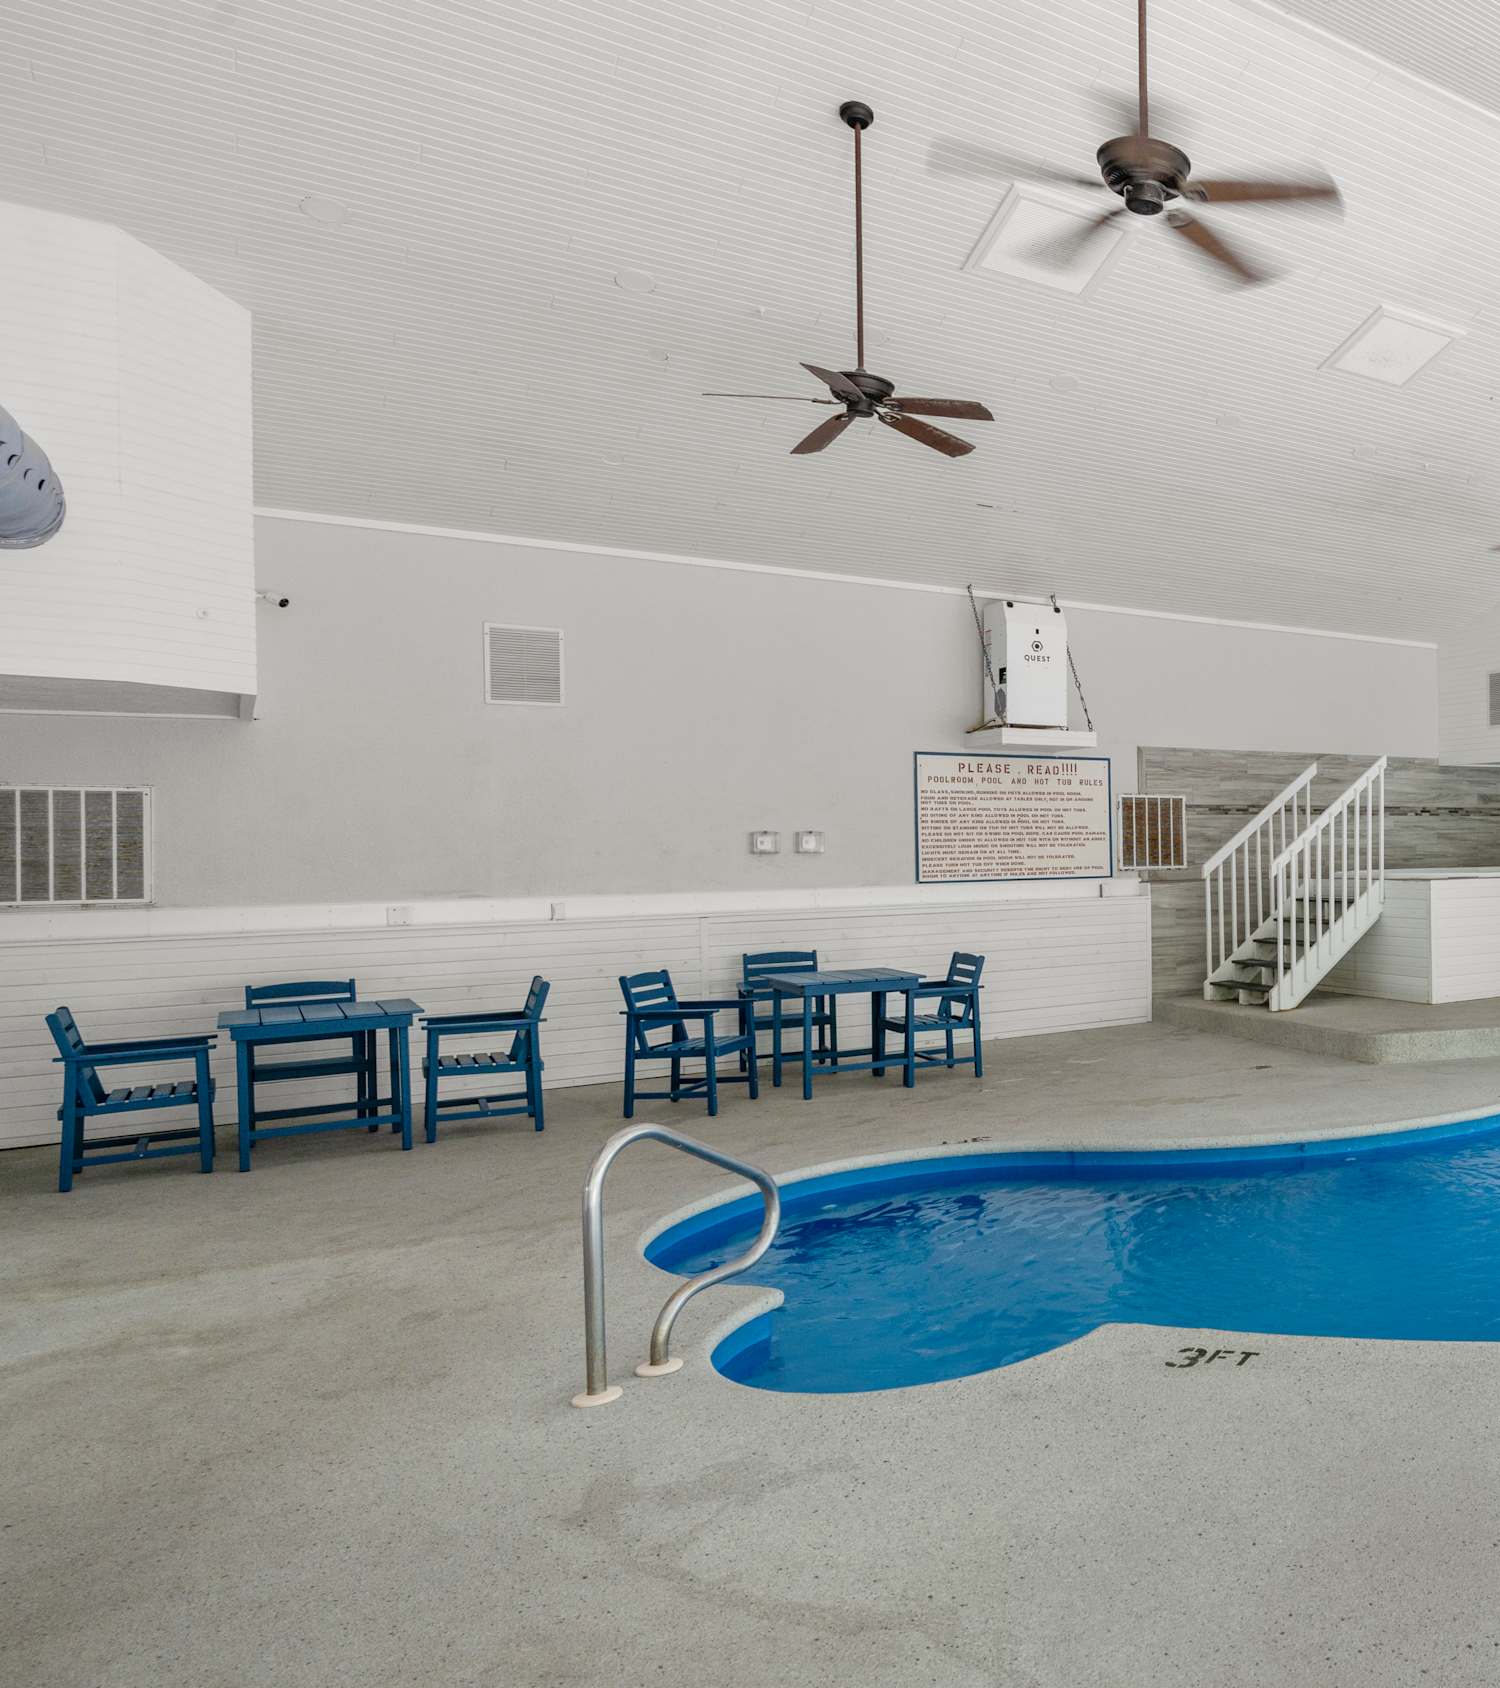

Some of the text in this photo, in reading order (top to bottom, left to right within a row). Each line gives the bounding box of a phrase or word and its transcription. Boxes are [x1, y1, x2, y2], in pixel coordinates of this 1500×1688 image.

[1024, 654, 1051, 663] QUEST
[958, 762, 1077, 776] PLEASE READ!!!!
[981, 776, 1002, 784] POOL
[1164, 1346, 1260, 1369] 3FT
